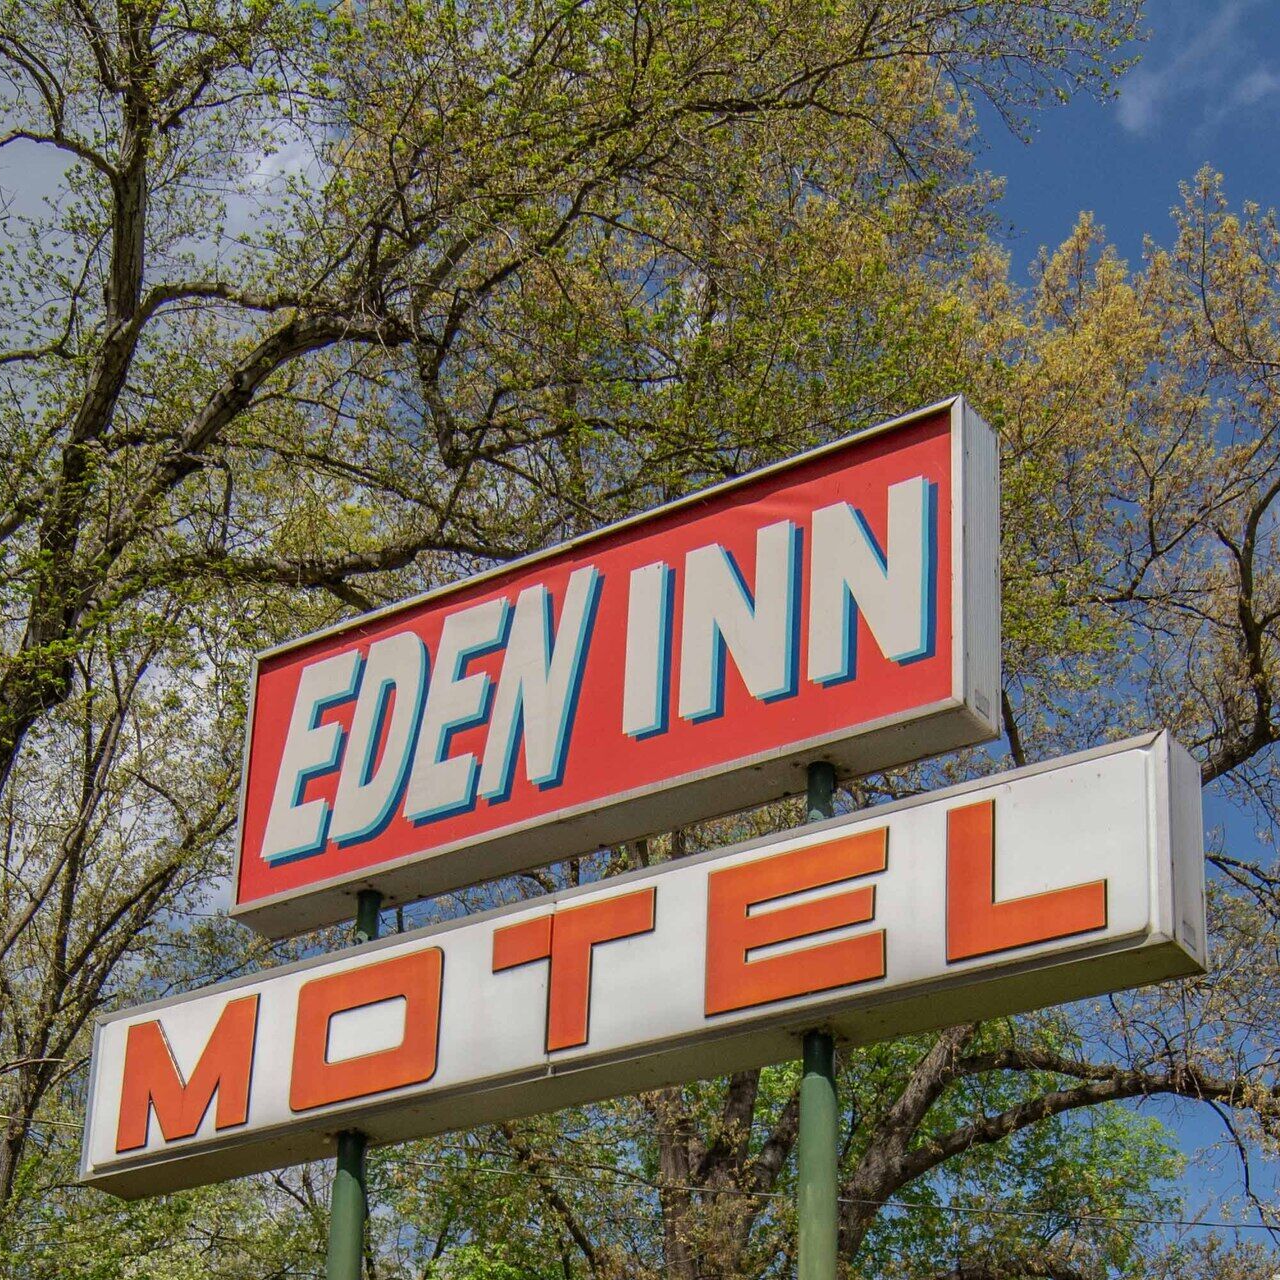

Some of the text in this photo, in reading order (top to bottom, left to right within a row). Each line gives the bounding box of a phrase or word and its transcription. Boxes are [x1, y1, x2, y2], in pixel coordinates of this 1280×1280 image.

[261, 476, 937, 867] EDEN INN
[116, 799, 1108, 1153] MOTEL
